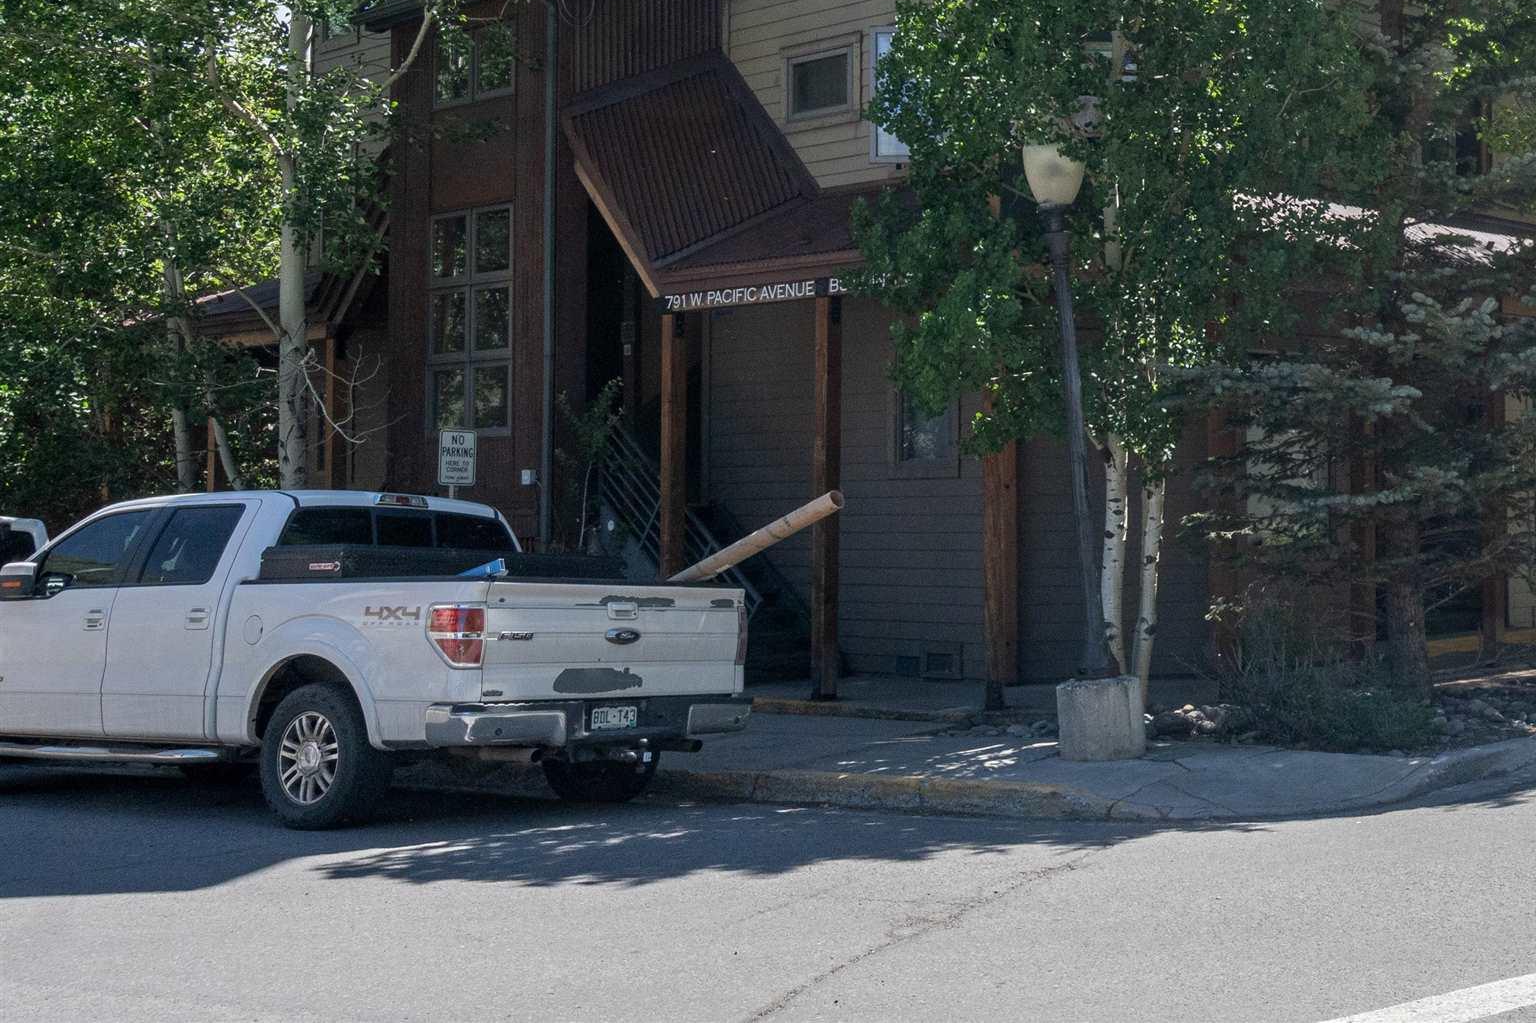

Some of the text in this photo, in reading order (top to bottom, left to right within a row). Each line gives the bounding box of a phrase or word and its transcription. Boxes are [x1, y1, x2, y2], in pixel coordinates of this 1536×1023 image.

[665, 294, 686, 309] 791
[707, 287, 757, 304] PACIFIC
[760, 281, 815, 299] AVENUE
[452, 435, 465, 445] NO
[442, 447, 474, 457] PARKING
[364, 606, 420, 621] 4X4
